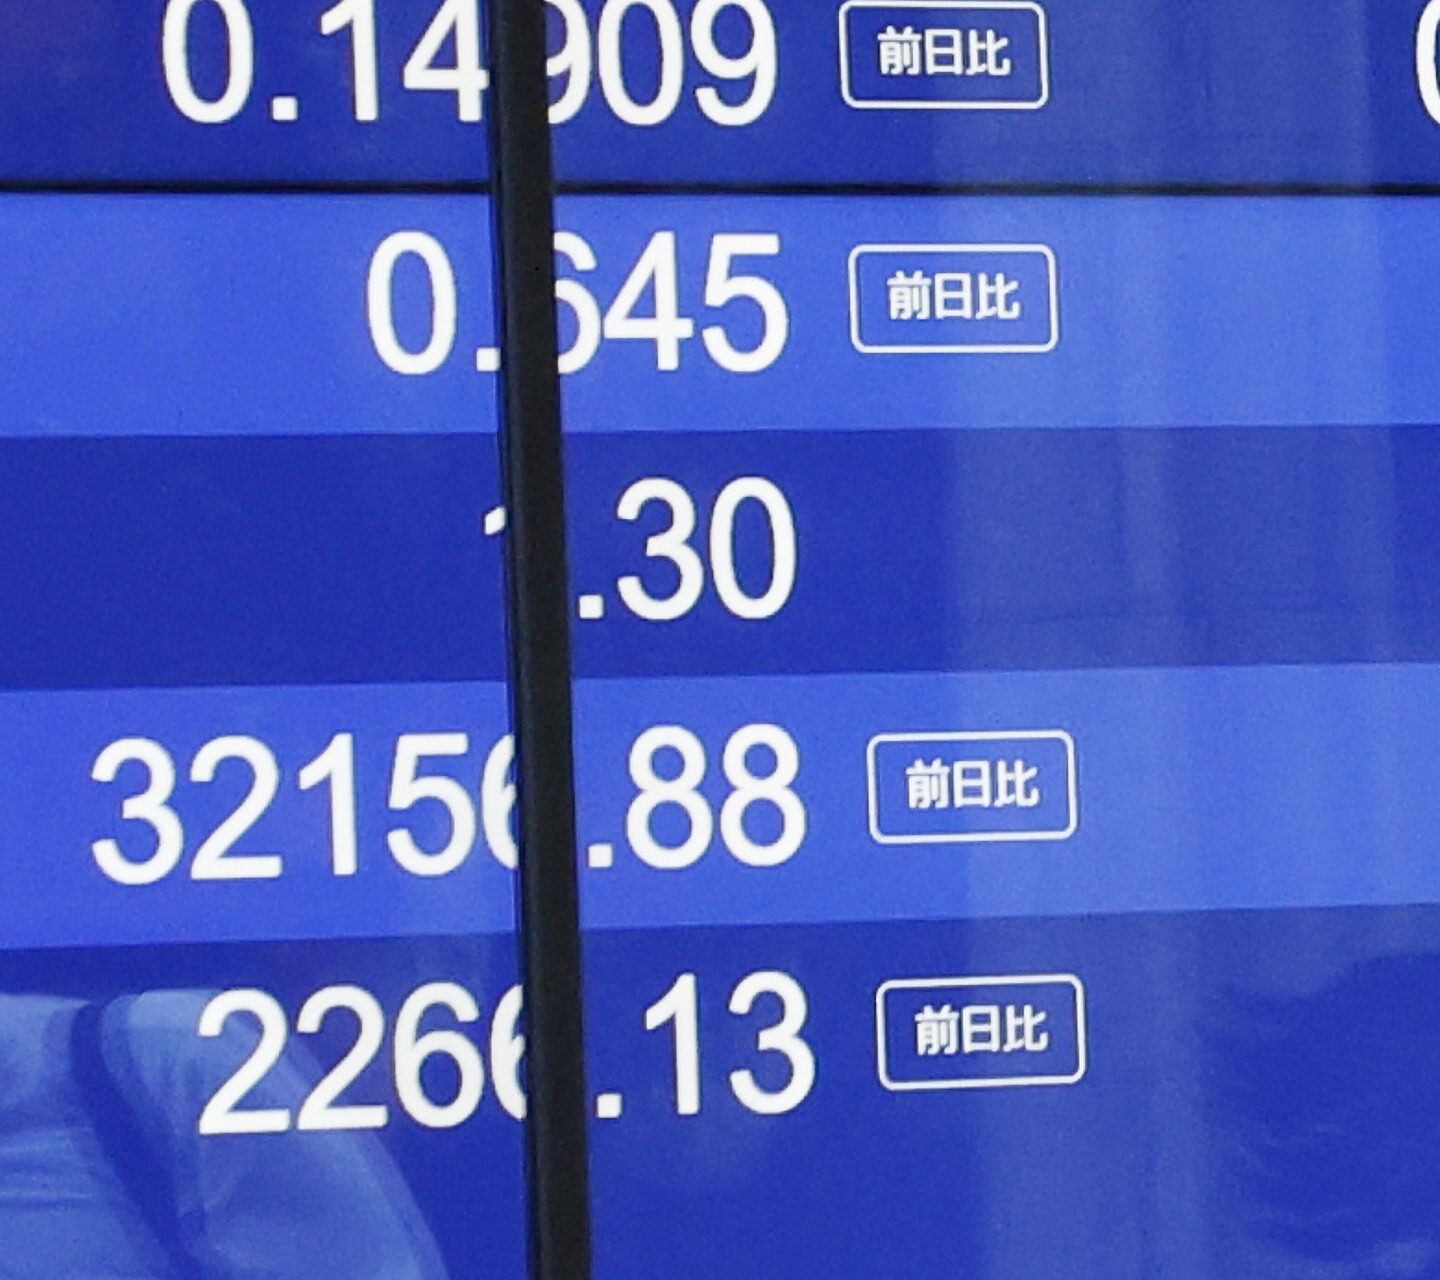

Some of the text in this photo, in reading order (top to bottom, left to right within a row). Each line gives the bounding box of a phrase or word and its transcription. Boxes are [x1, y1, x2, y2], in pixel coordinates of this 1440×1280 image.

[876, 24, 1012, 77] 前日比
[886, 270, 1021, 321] 前日比
[483, 476, 797, 621] .30
[905, 758, 1040, 810] 前日比
[914, 1004, 1049, 1056] 前日比
